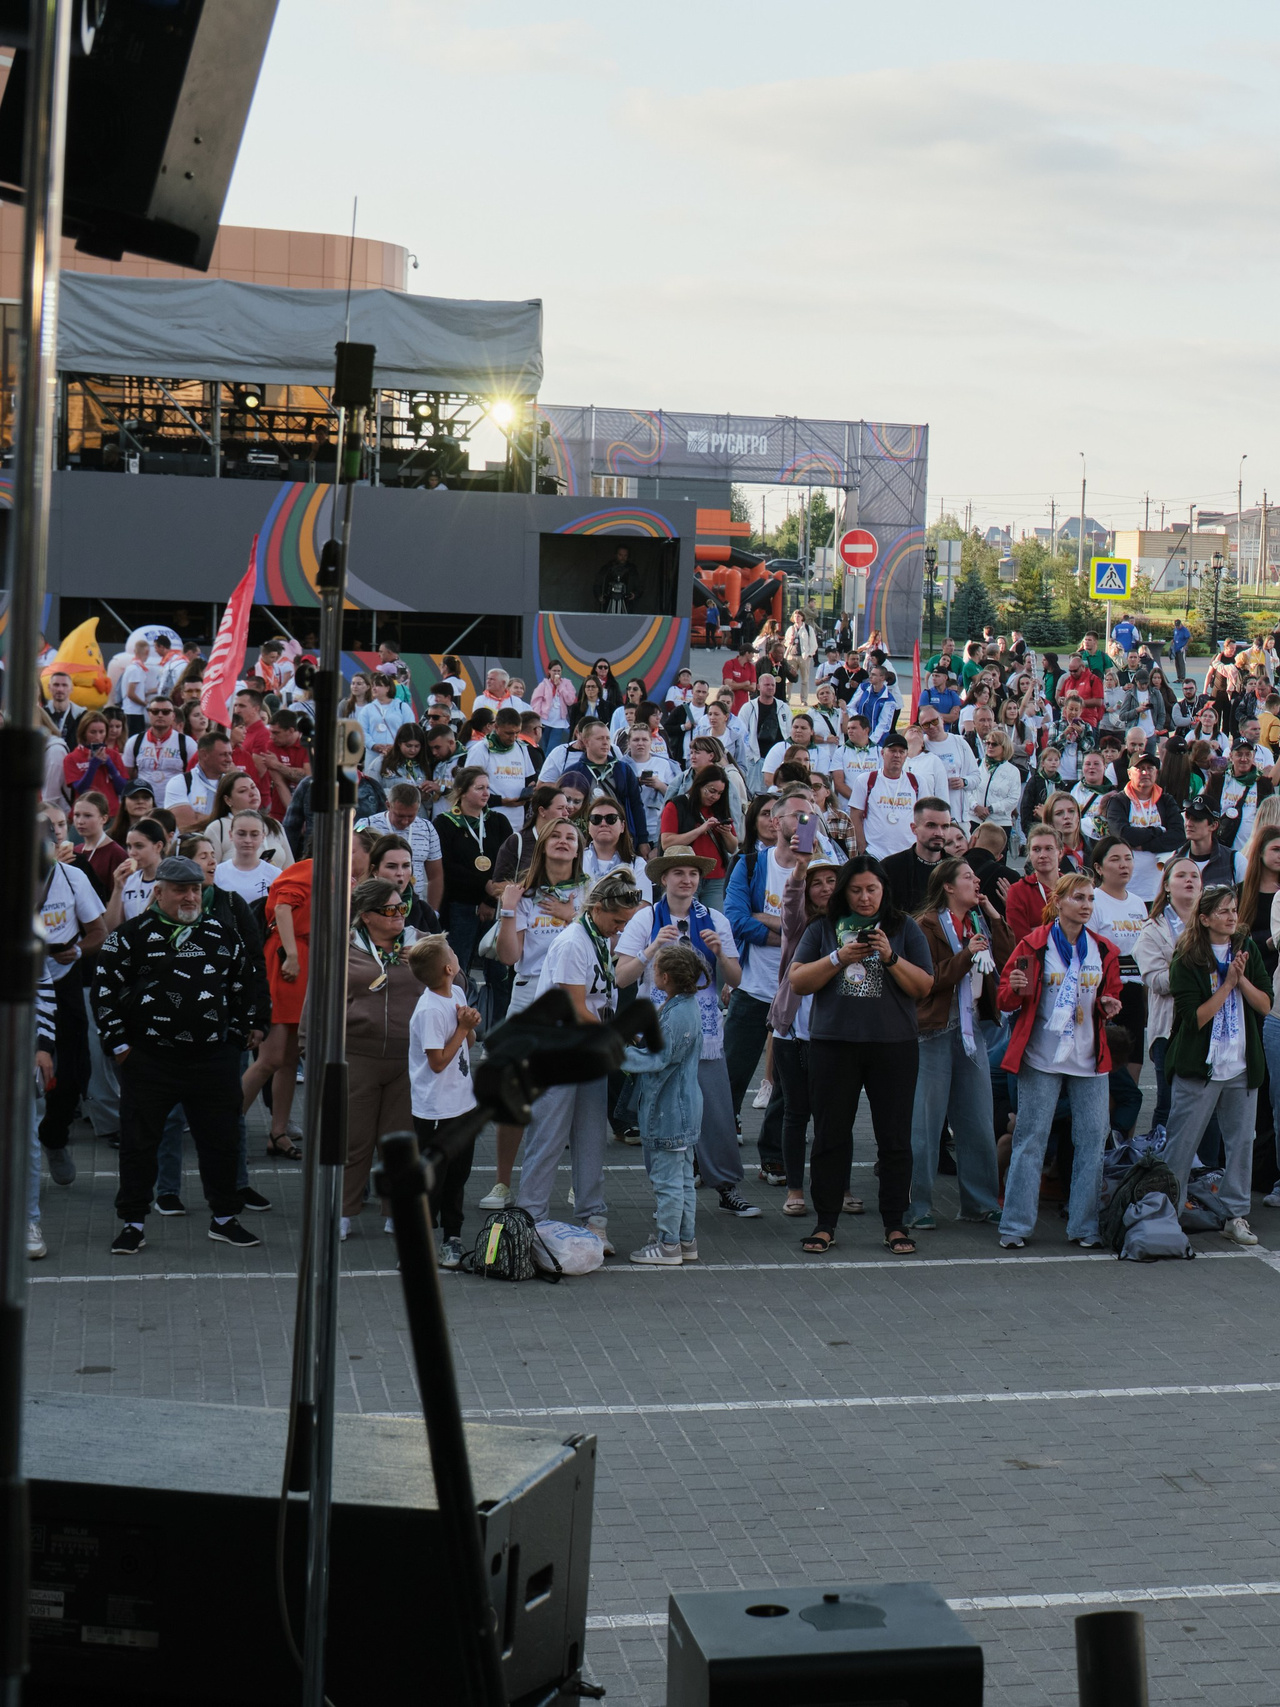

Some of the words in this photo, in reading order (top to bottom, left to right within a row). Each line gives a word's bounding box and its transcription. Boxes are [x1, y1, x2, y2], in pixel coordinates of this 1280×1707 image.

[711, 432, 768, 455] РУСАГРО
[877, 796, 912, 807] ЛЮДИ
[43, 910, 67, 927] ДИ
[531, 916, 568, 929] ЛЮ
